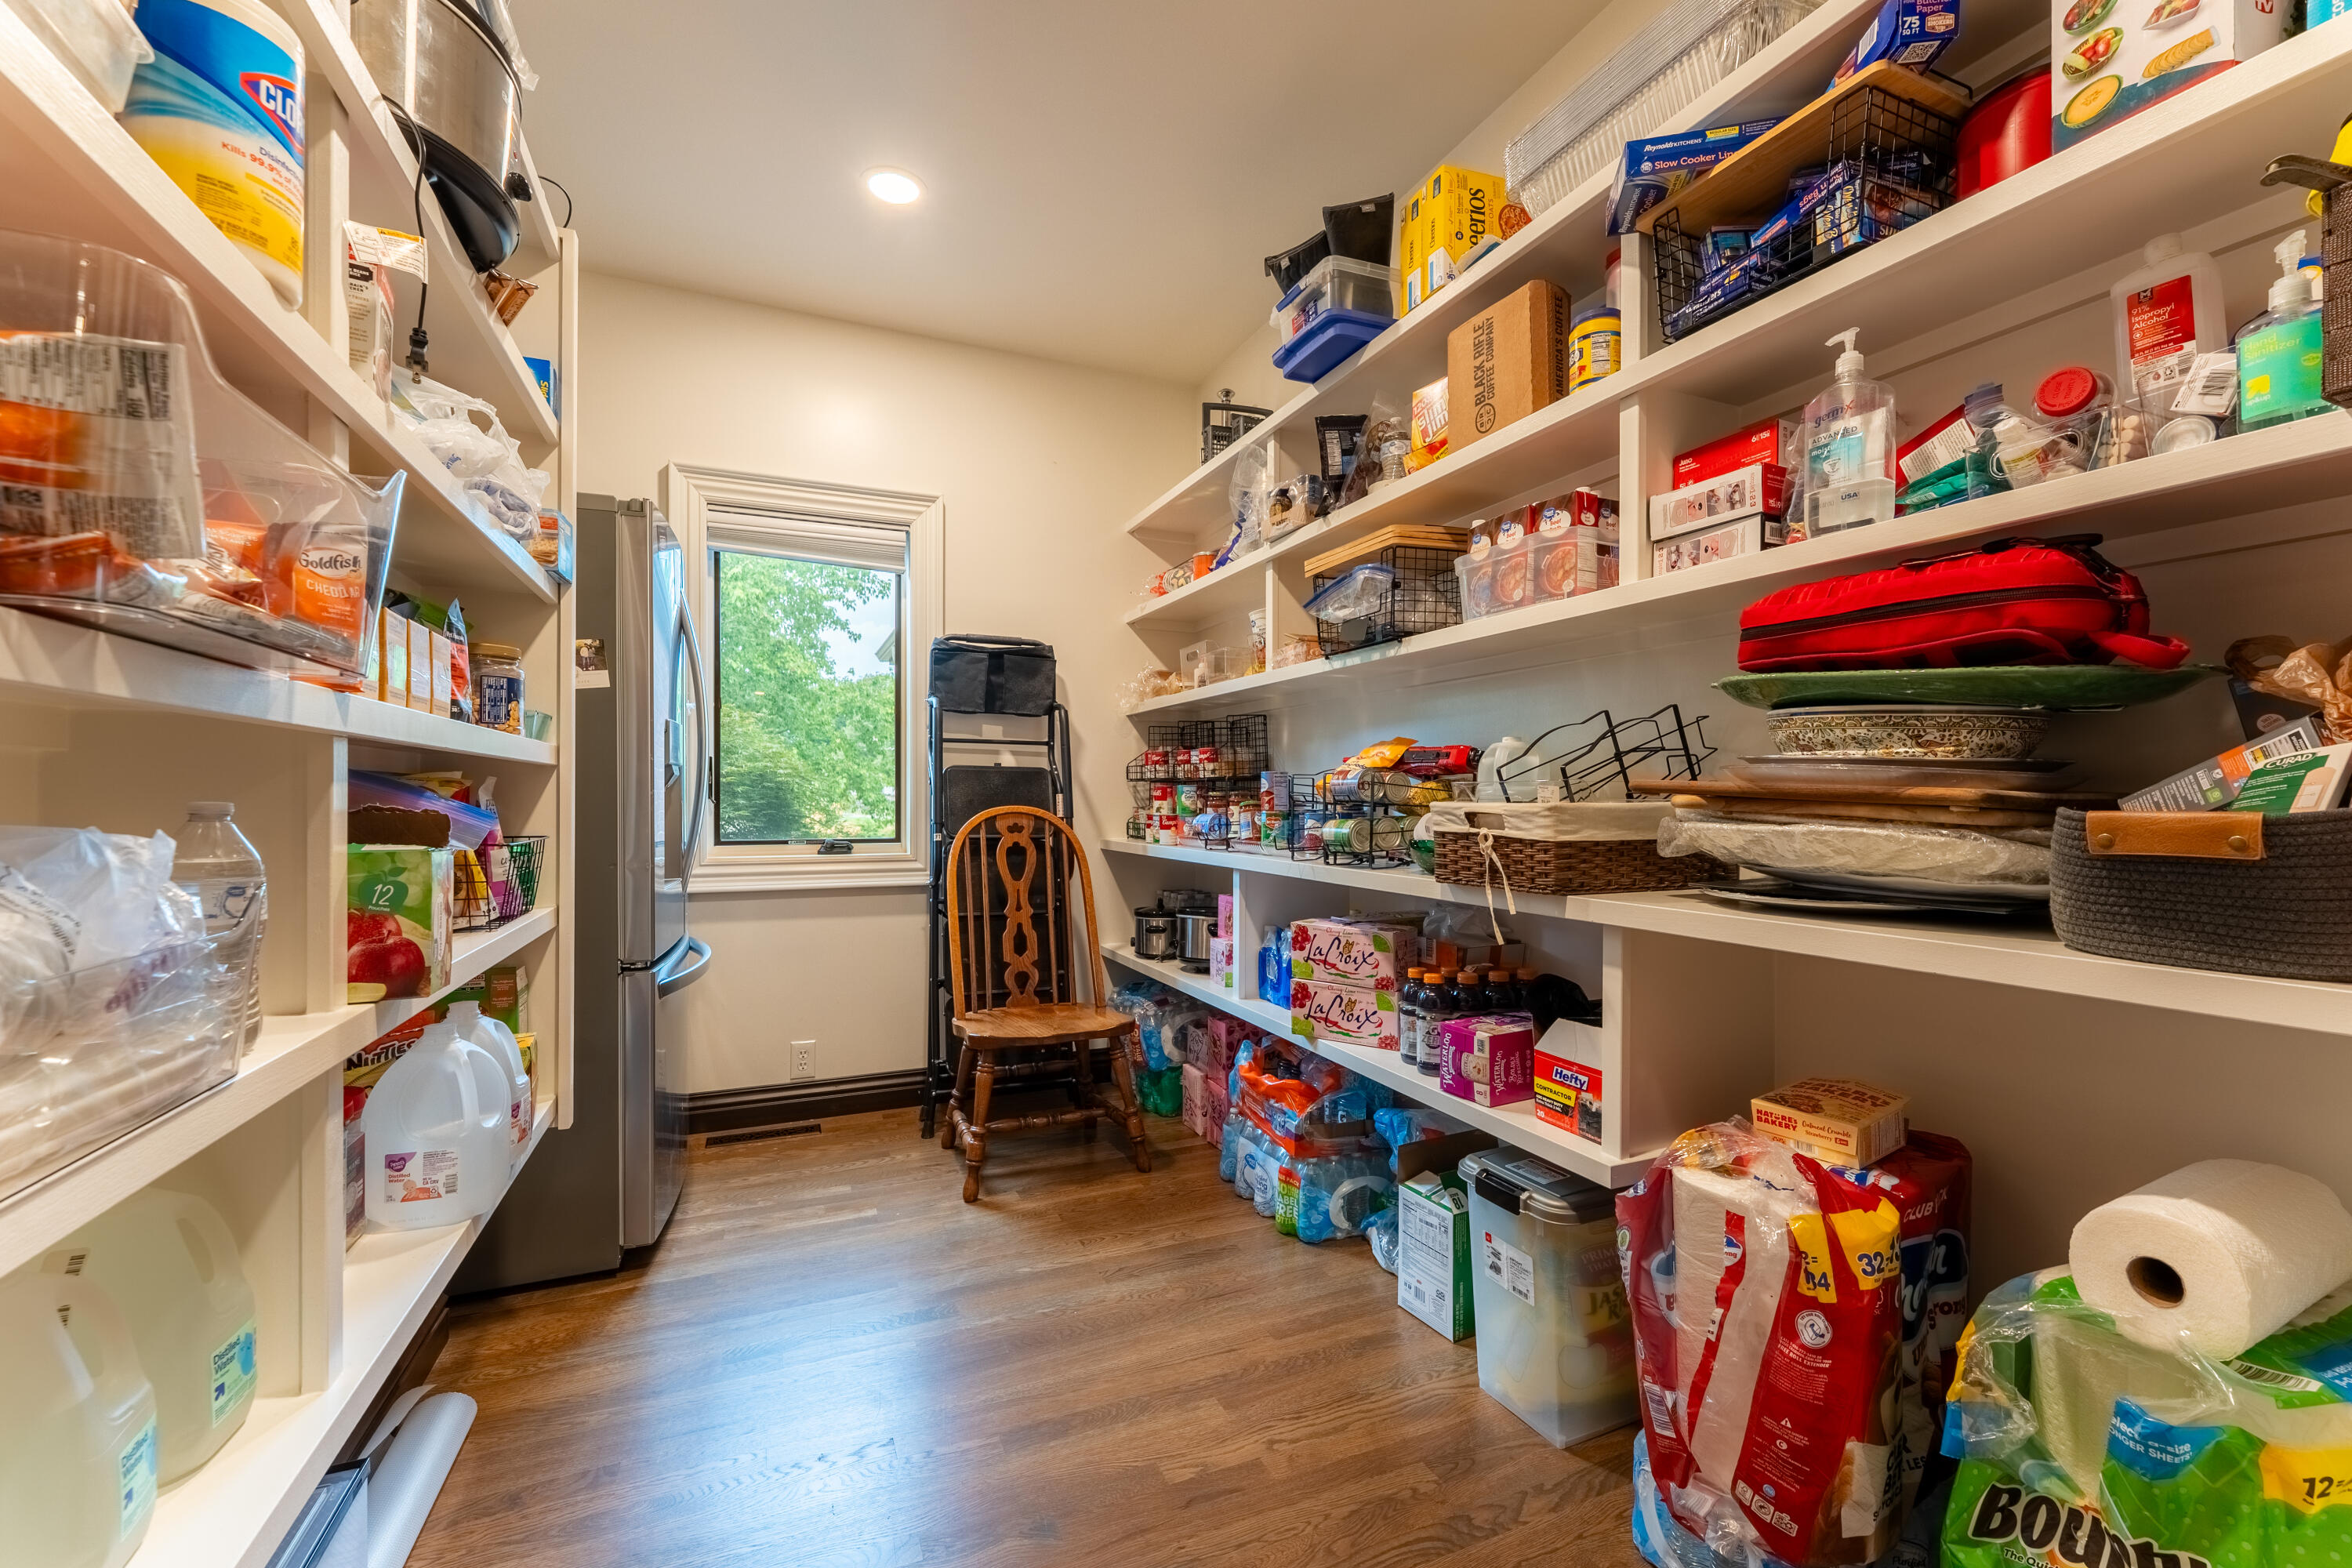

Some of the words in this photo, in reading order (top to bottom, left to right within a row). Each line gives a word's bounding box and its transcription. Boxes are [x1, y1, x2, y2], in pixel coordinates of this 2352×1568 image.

[1916, 5, 1944, 13] Paper
[1903, 16, 1920, 29] 75
[1644, 142, 1674, 152] Reynolds
[1673, 139, 1703, 147] KITCHENS
[221, 141, 246, 158] Kills
[250, 154, 283, 178] 99.9%
[1654, 159, 1678, 169] Slow
[1680, 154, 1716, 165] Cooker
[1554, 293, 1563, 336] COFFEE
[2132, 305, 2150, 315] 91%
[2132, 303, 2175, 322] Isopropyl
[2132, 313, 2169, 330] Alcohol
[1474, 320, 1485, 360] RIFLE
[1486, 315, 1494, 362] COMPANY
[2245, 332, 2278, 351] Hand
[1474, 360, 1486, 408] BLACK
[1486, 364, 1495, 401] COFFEE
[1679, 457, 1693, 466] Juno
[1841, 492, 1858, 500] USA
[299, 551, 361, 569] Goldfish
[2265, 753, 2313, 769] CURAD
[372, 884, 394, 905] 12
[368, 904, 390, 913] Pouches
[1326, 927, 1341, 935] Cherry
[1421, 1035, 1440, 1047] ZER
[1442, 1033, 1455, 1087] WATERLOO
[1493, 1051, 1505, 1095] WATERLOO
[1554, 1068, 1586, 1090] Hefty
[1536, 1083, 1572, 1102] CONTRACTOR
[1537, 1109, 1545, 1117] 20
[1756, 1116, 1798, 1131] BAKERY
[1802, 1120, 1827, 1132] Oatmeal
[1827, 1127, 1851, 1138] Crumble
[1805, 1130, 1832, 1142] Strawberry
[1452, 1197, 1465, 1210] 18
[1903, 1201, 1933, 1223] CLUB
[1857, 1251, 1886, 1278] 32
[213, 1335, 241, 1365] Distilled
[1777, 1344, 1790, 1354] FREE
[1789, 1351, 1802, 1362] ROLL
[215, 1352, 236, 1374] Water
[2004, 1548, 2024, 1563] The
